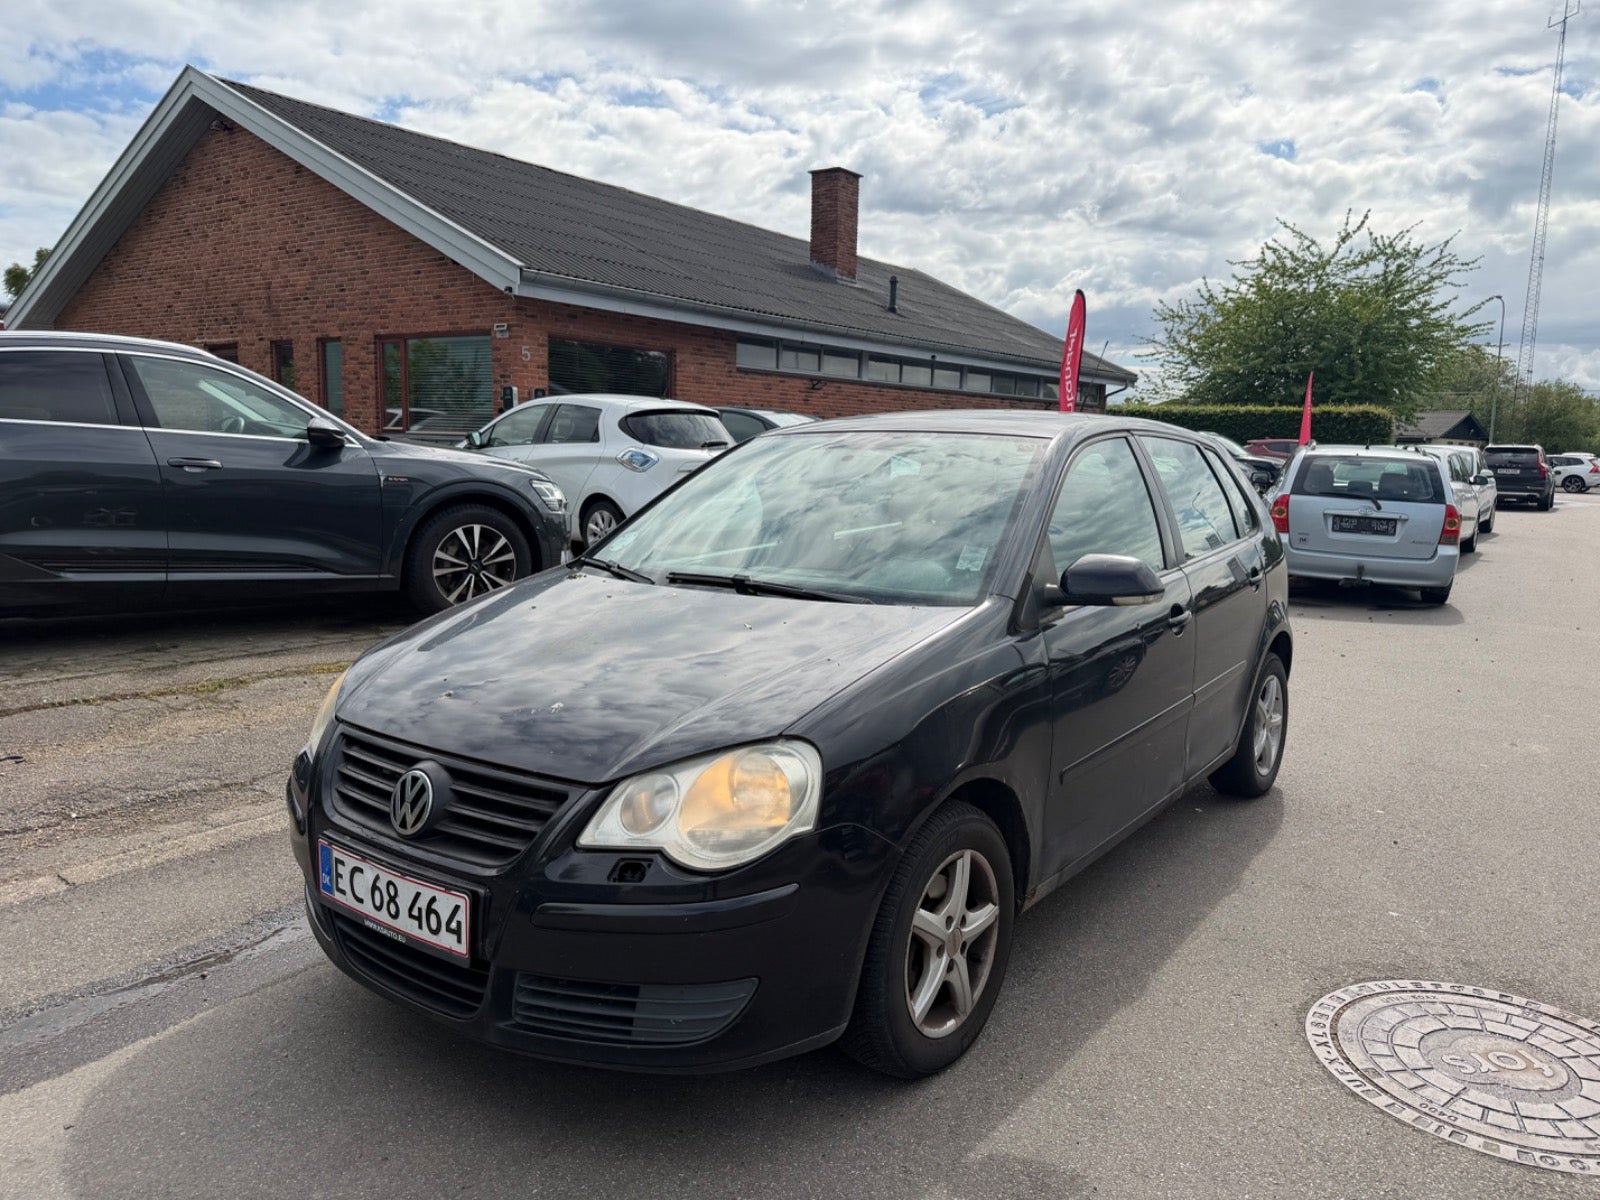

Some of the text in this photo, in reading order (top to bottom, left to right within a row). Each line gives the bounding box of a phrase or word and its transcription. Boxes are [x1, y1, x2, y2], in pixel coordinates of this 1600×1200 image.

[522, 346, 531, 361] 5
[322, 873, 332, 886] DK
[335, 857, 462, 944] EC 68 464
[1441, 1050, 1556, 1078] fors
[1419, 1102, 1459, 1122] D400
